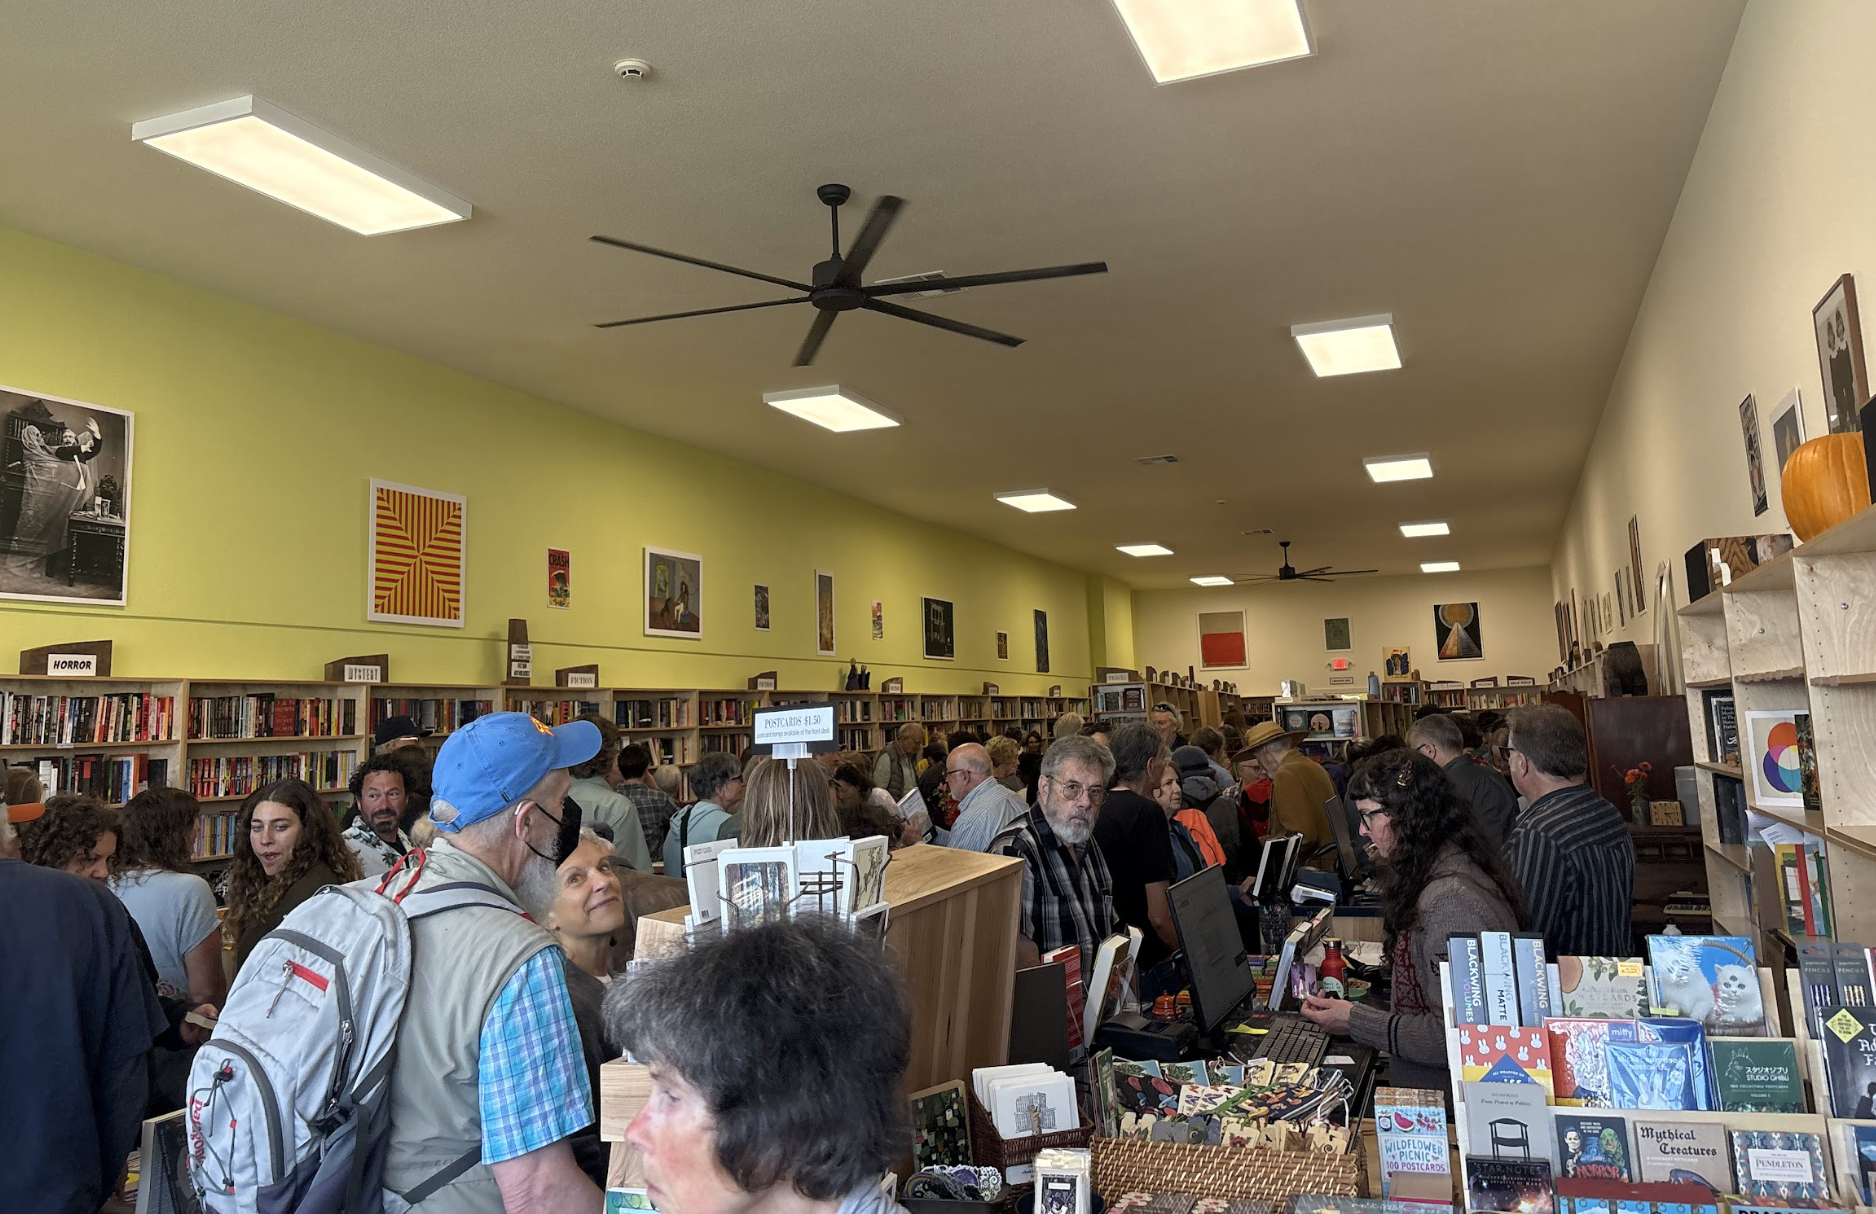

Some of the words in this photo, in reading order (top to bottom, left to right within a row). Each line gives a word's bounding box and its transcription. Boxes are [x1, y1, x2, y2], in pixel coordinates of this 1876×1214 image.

[548, 553, 570, 568] CRASH
[53, 660, 92, 670] HORROR
[570, 676, 594, 685] FICTION
[764, 716, 802, 729] POSTCARDS
[804, 714, 821, 727] $1.50
[784, 729, 800, 737] available
[1466, 939, 1482, 1007] BLACKWING
[1498, 933, 1515, 1003] BLACKWING
[1532, 940, 1548, 1009] BLACKWING
[1462, 977, 1474, 1023] VOLUMES
[1497, 989, 1508, 1021] MATTE
[1611, 1029, 1633, 1038] miffy
[1745, 1066, 1789, 1074] スタジオジブリ
[1640, 1126, 1697, 1143] Mythical
[1385, 1139, 1444, 1158] WILDFLOWER
[1659, 1142, 1717, 1156] Creatures
[1399, 1150, 1430, 1162] PICNIC
[1386, 1161, 1399, 1170] 100
[1401, 1162, 1446, 1172] POSTCARDS
[1476, 1164, 1502, 1173] STAR
[1505, 1165, 1542, 1175] NOTES
[1755, 1158, 1804, 1169] PENDLETON
[1575, 1163, 1620, 1179] HORROR
